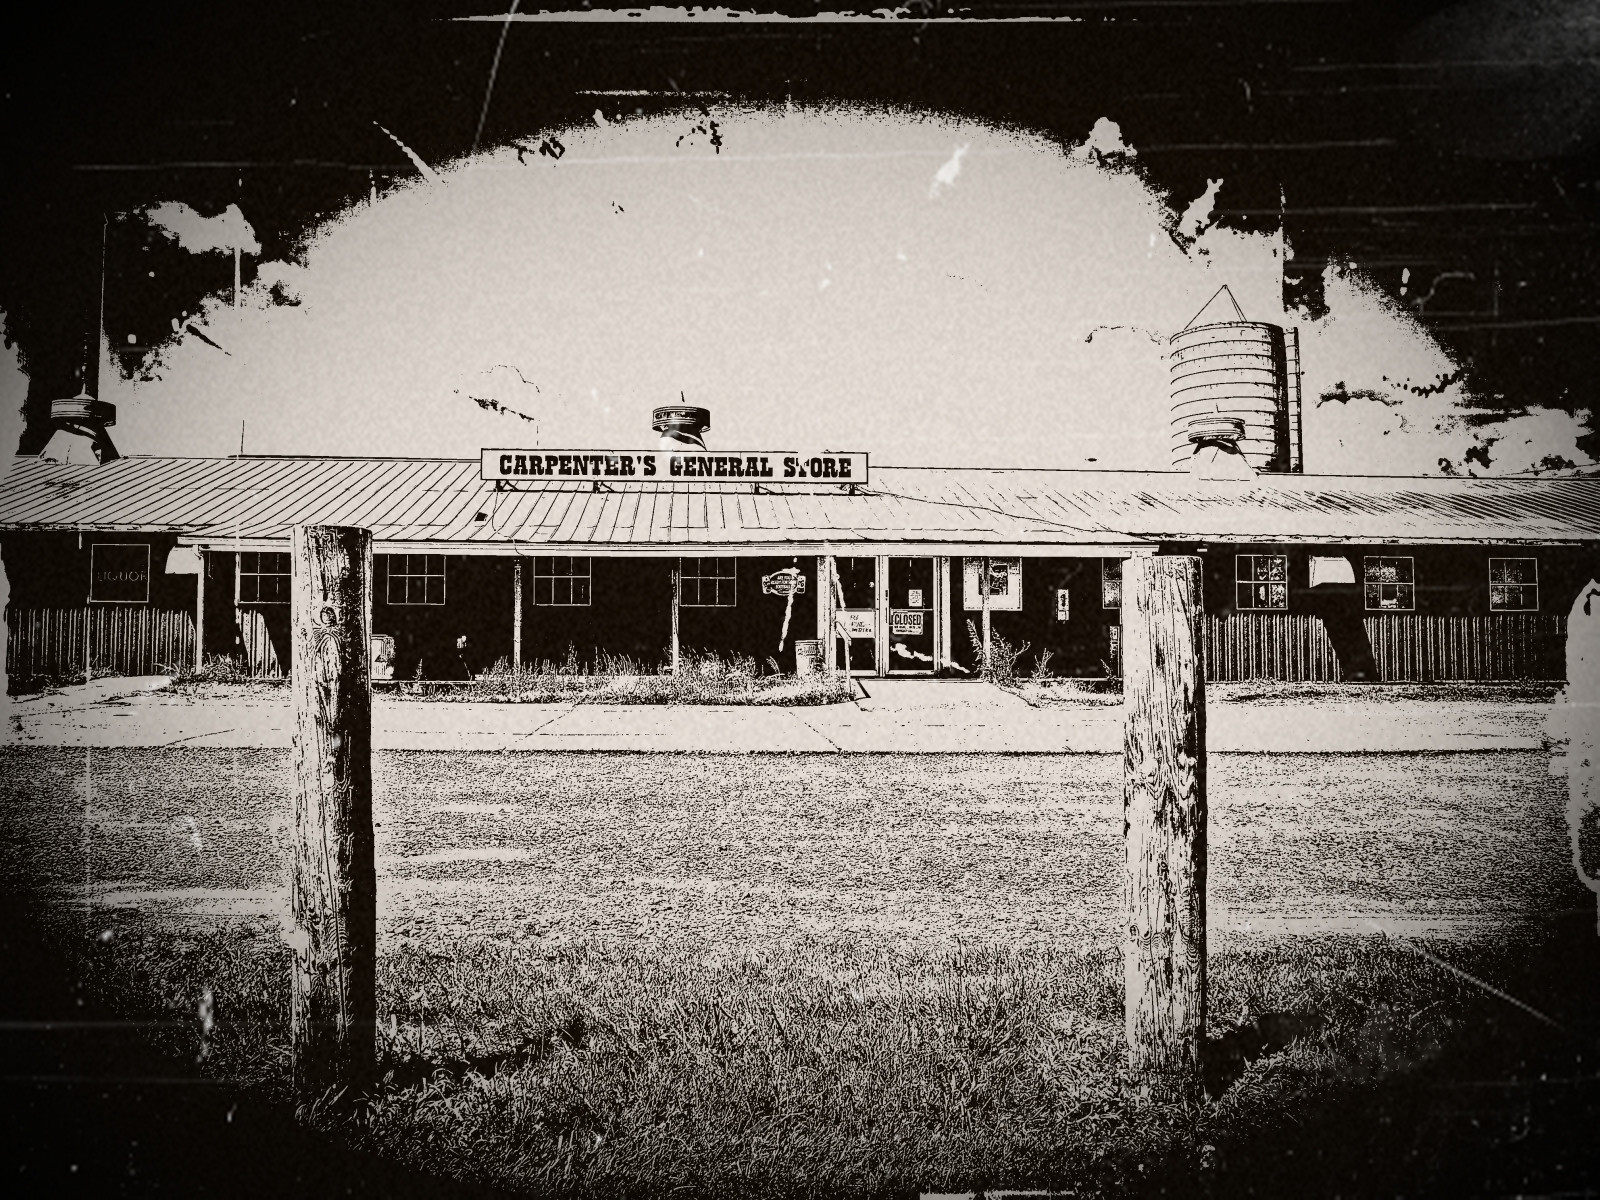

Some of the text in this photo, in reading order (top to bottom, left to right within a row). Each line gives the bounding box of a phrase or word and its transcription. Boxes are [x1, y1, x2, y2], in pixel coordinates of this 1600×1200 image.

[499, 454, 852, 478] CARPENTER'S GENERAL STORE
[97, 570, 148, 582] LIQUOR
[894, 613, 922, 626] CLOSED
